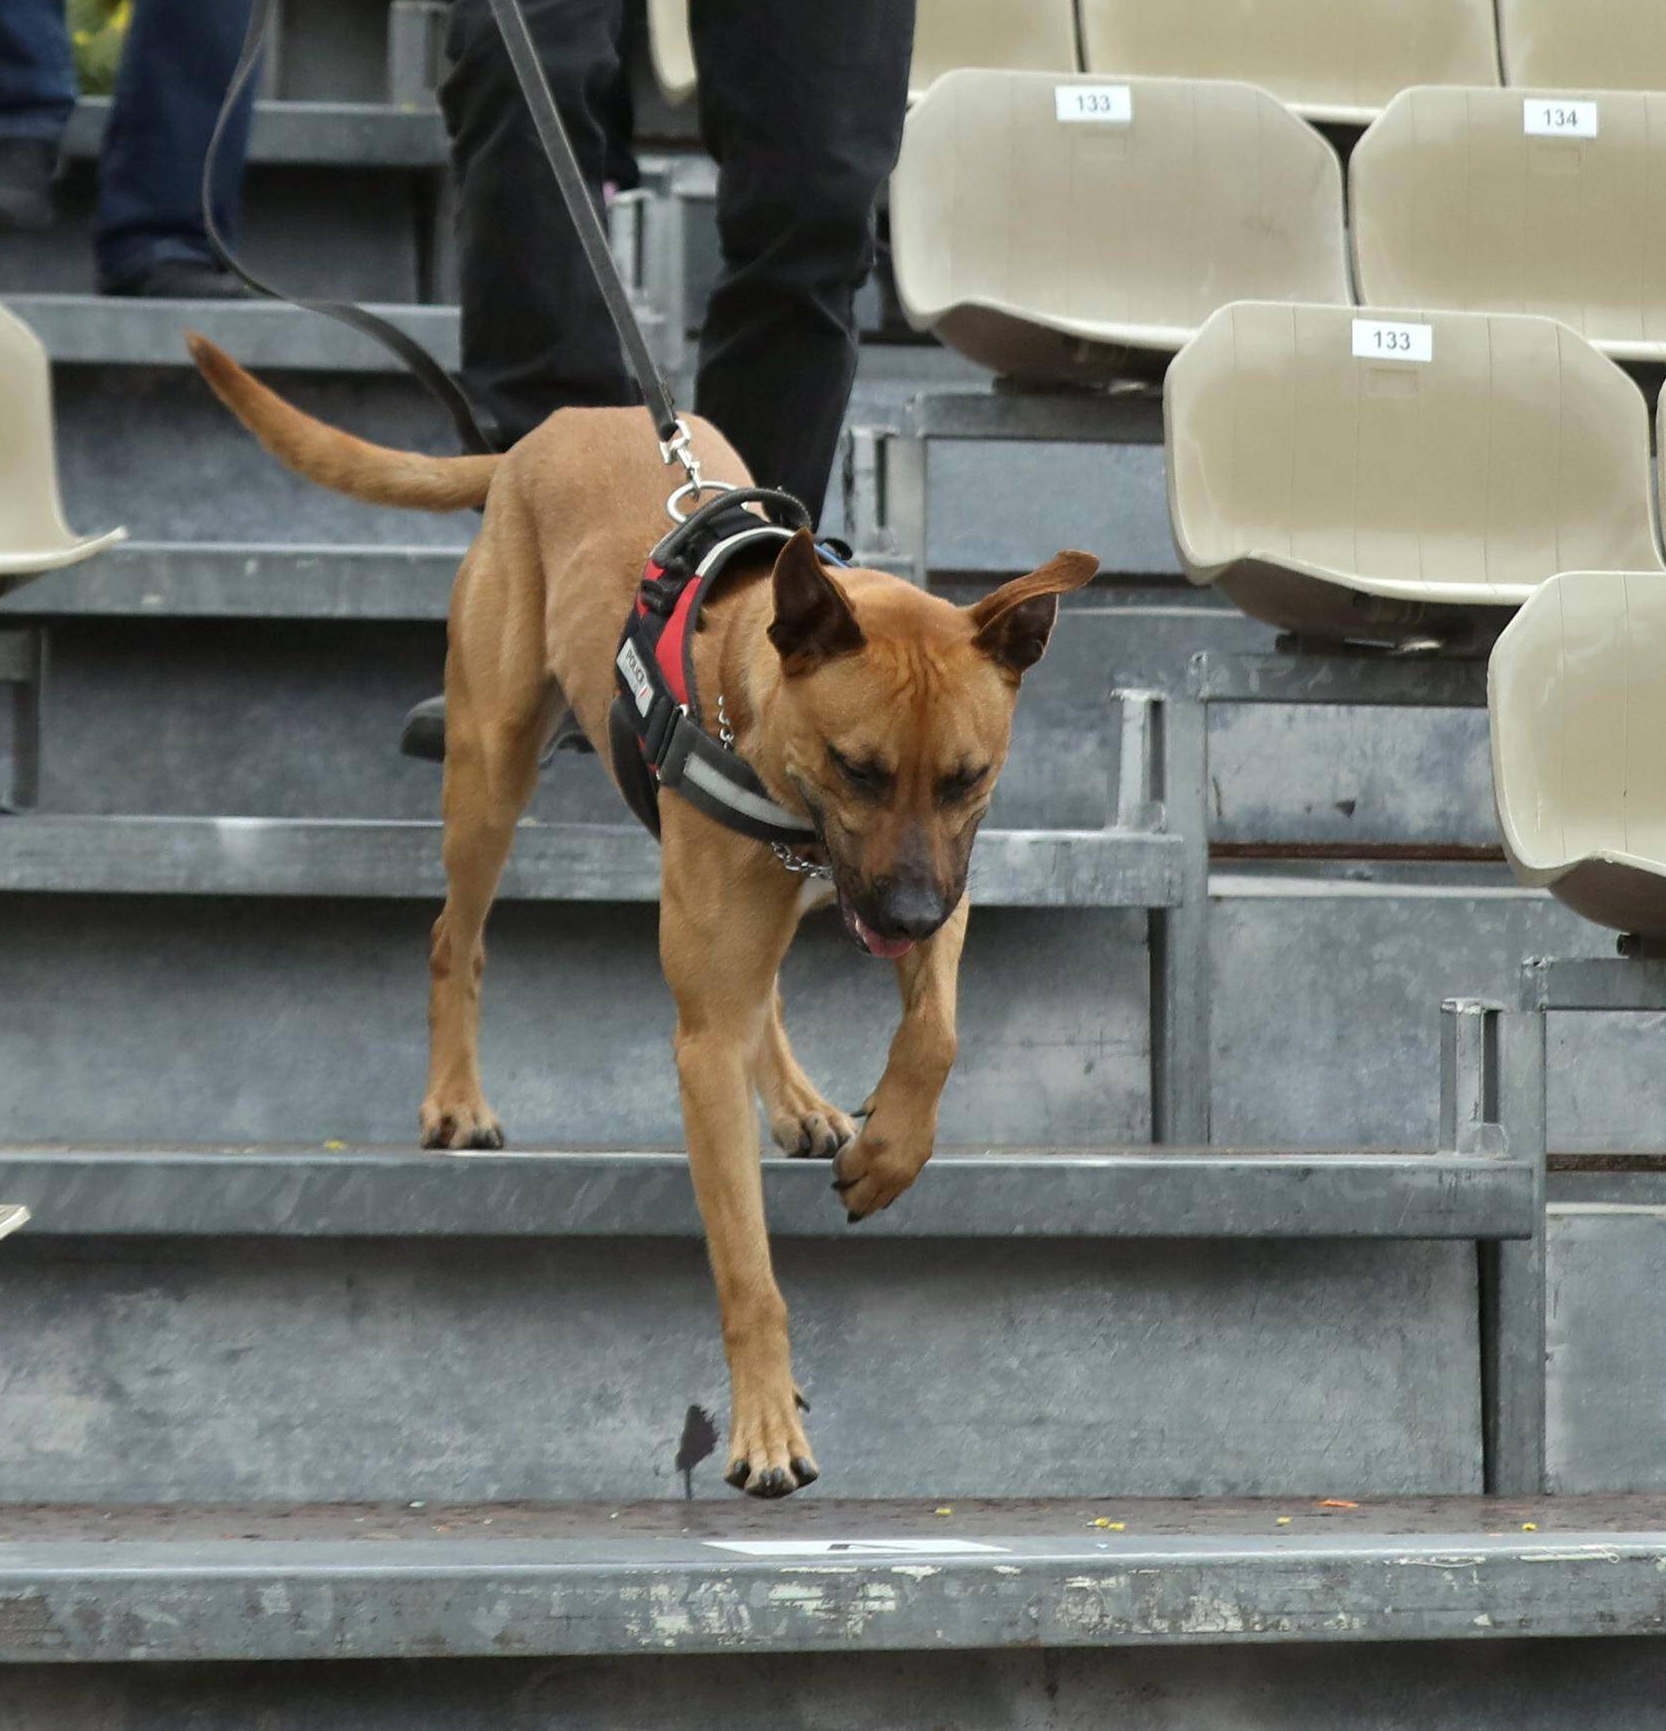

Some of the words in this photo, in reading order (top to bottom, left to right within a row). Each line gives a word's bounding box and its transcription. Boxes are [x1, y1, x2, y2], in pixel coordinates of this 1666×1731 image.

[1077, 94, 1110, 113] 133
[1543, 108, 1577, 127] 134
[1373, 330, 1410, 351] 133
